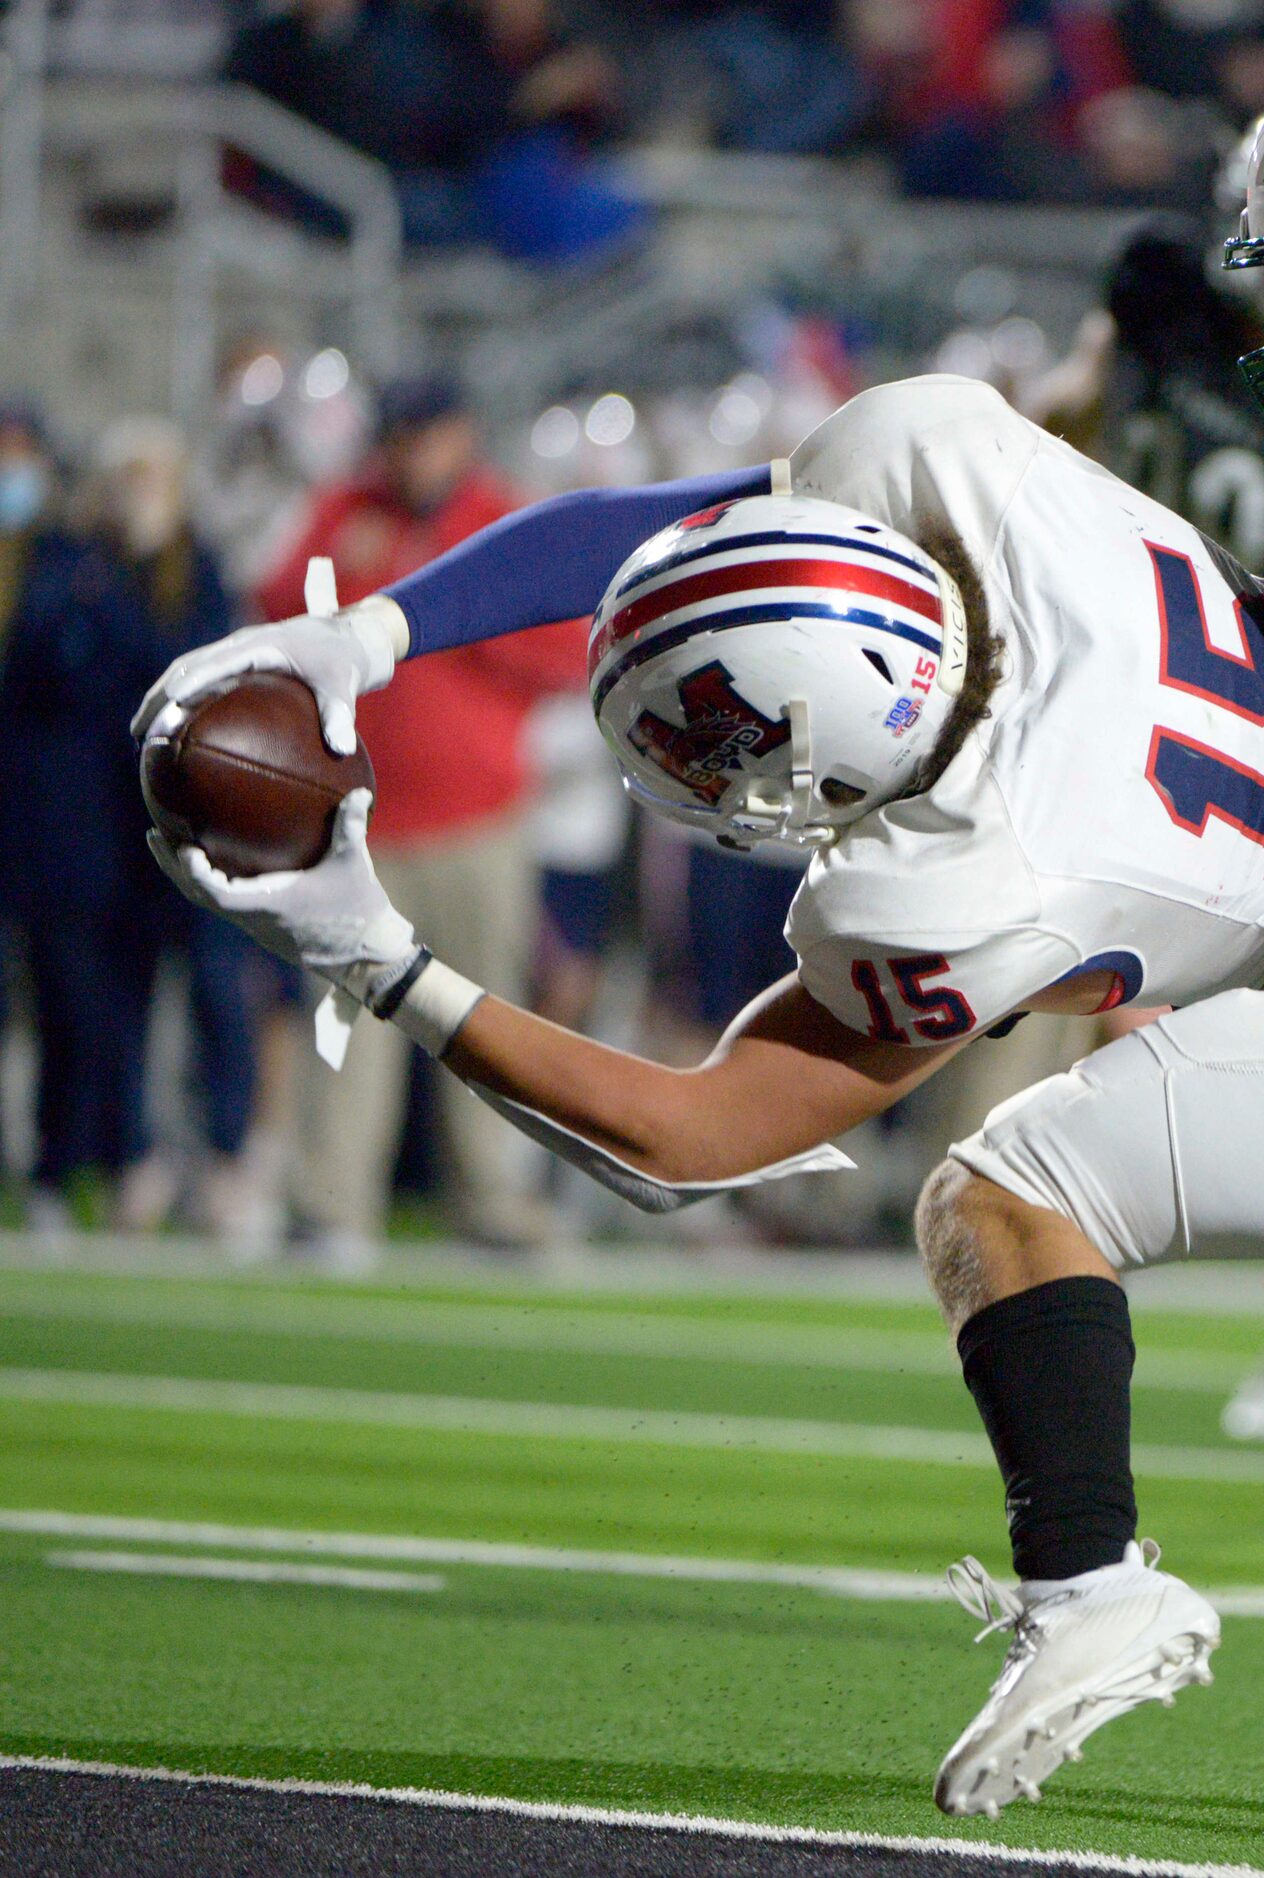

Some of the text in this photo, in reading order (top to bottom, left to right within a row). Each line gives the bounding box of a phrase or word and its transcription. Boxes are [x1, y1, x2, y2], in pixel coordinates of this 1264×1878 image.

[911, 656, 937, 695] 15
[883, 696, 911, 730] 100
[684, 726, 764, 784] BOYD
[851, 953, 978, 1044] 15
